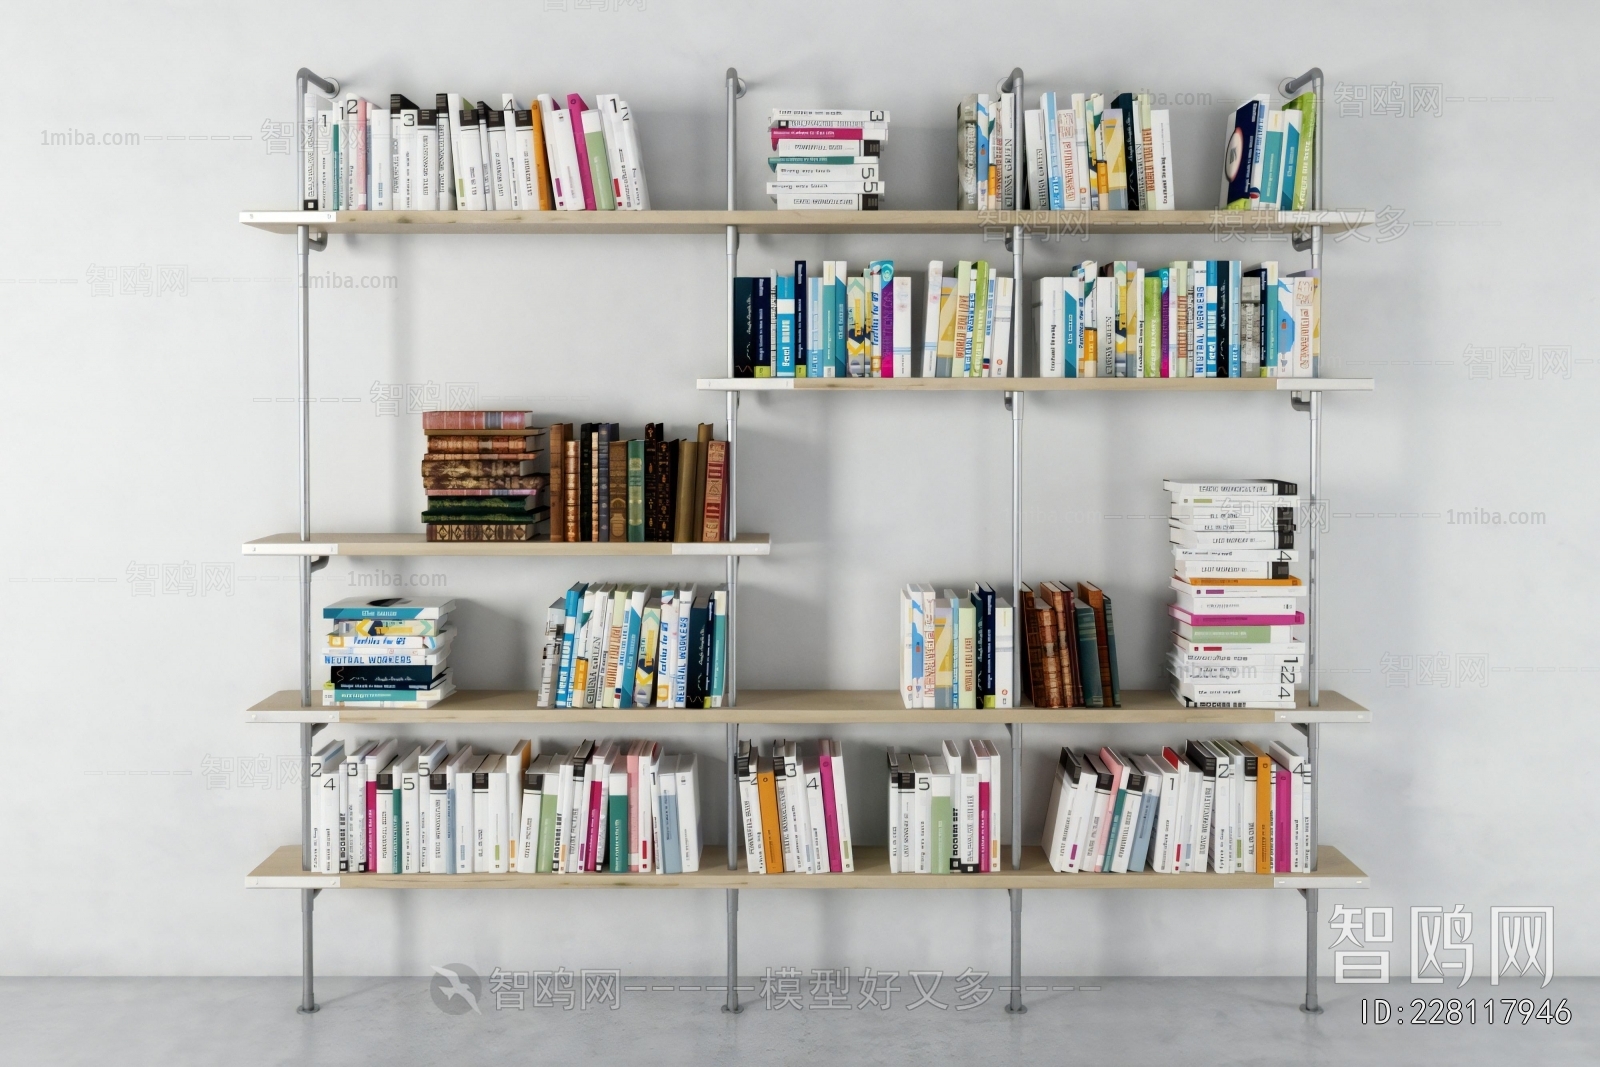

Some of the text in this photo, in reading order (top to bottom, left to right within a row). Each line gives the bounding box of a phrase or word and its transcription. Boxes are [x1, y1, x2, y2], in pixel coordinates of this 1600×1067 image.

[347, 99, 358, 114] 2
[403, 113, 415, 128] 3
[862, 167, 875, 180] 5
[1218, 763, 1229, 779] 2
[323, 777, 336, 791] 4
[403, 777, 415, 791] 5
[806, 777, 819, 790] 4
[918, 777, 930, 791] 5
